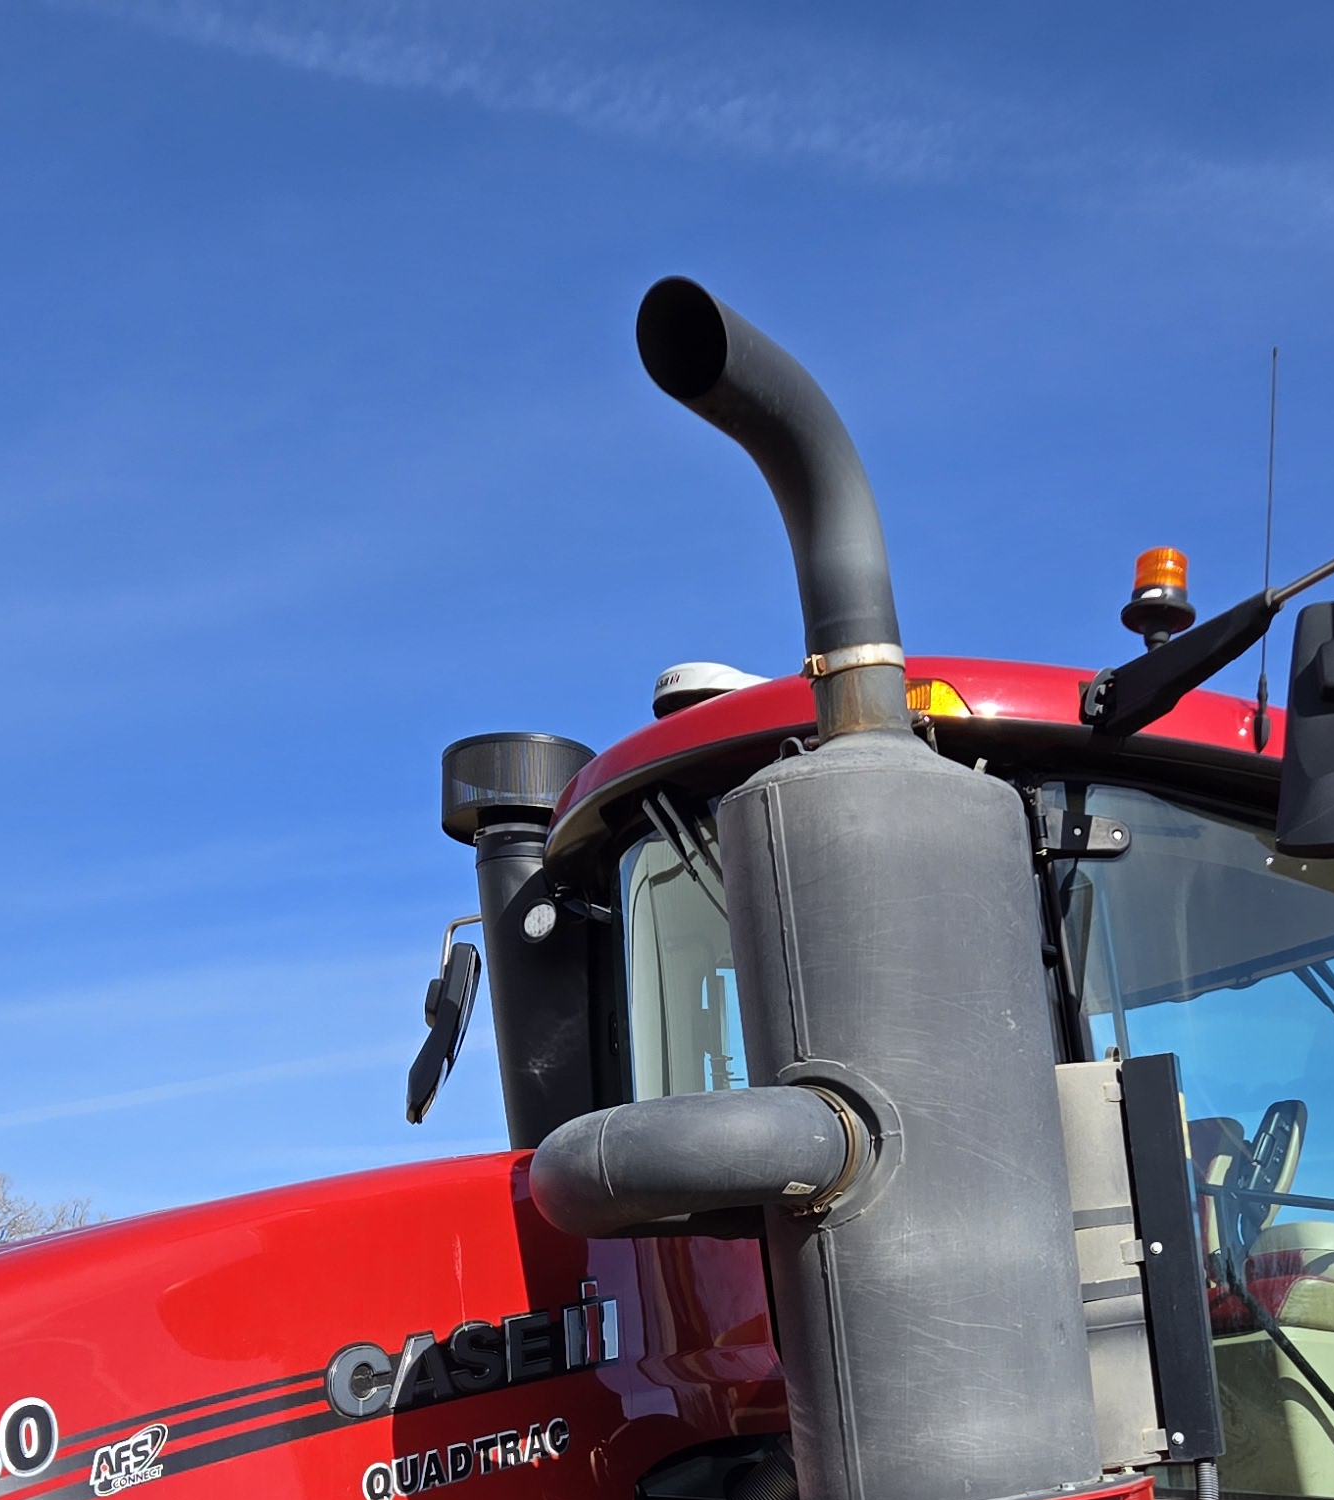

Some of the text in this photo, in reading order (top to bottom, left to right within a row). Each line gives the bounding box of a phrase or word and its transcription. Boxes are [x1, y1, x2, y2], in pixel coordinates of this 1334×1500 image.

[326, 1310, 553, 1418] CASE
[93, 1436, 151, 1483] AFS
[112, 1466, 163, 1489] CONNECT
